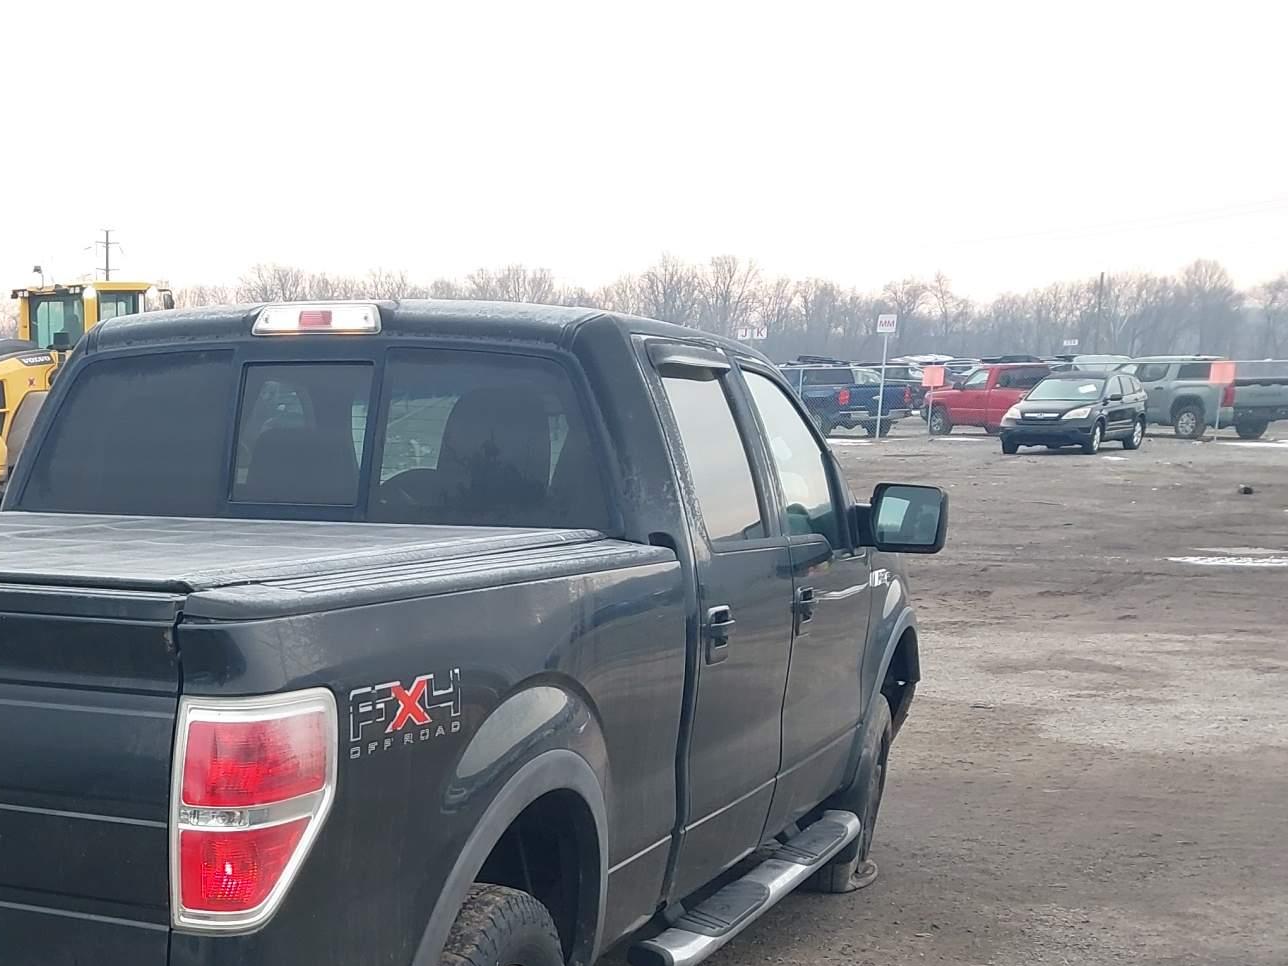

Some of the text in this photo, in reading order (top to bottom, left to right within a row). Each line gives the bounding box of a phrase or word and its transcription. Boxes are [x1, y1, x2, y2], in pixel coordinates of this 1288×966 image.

[878, 319, 896, 328] MM
[21, 355, 51, 364] VOLVO
[349, 667, 461, 741] FX4
[350, 721, 461, 759] OFF ROAD
